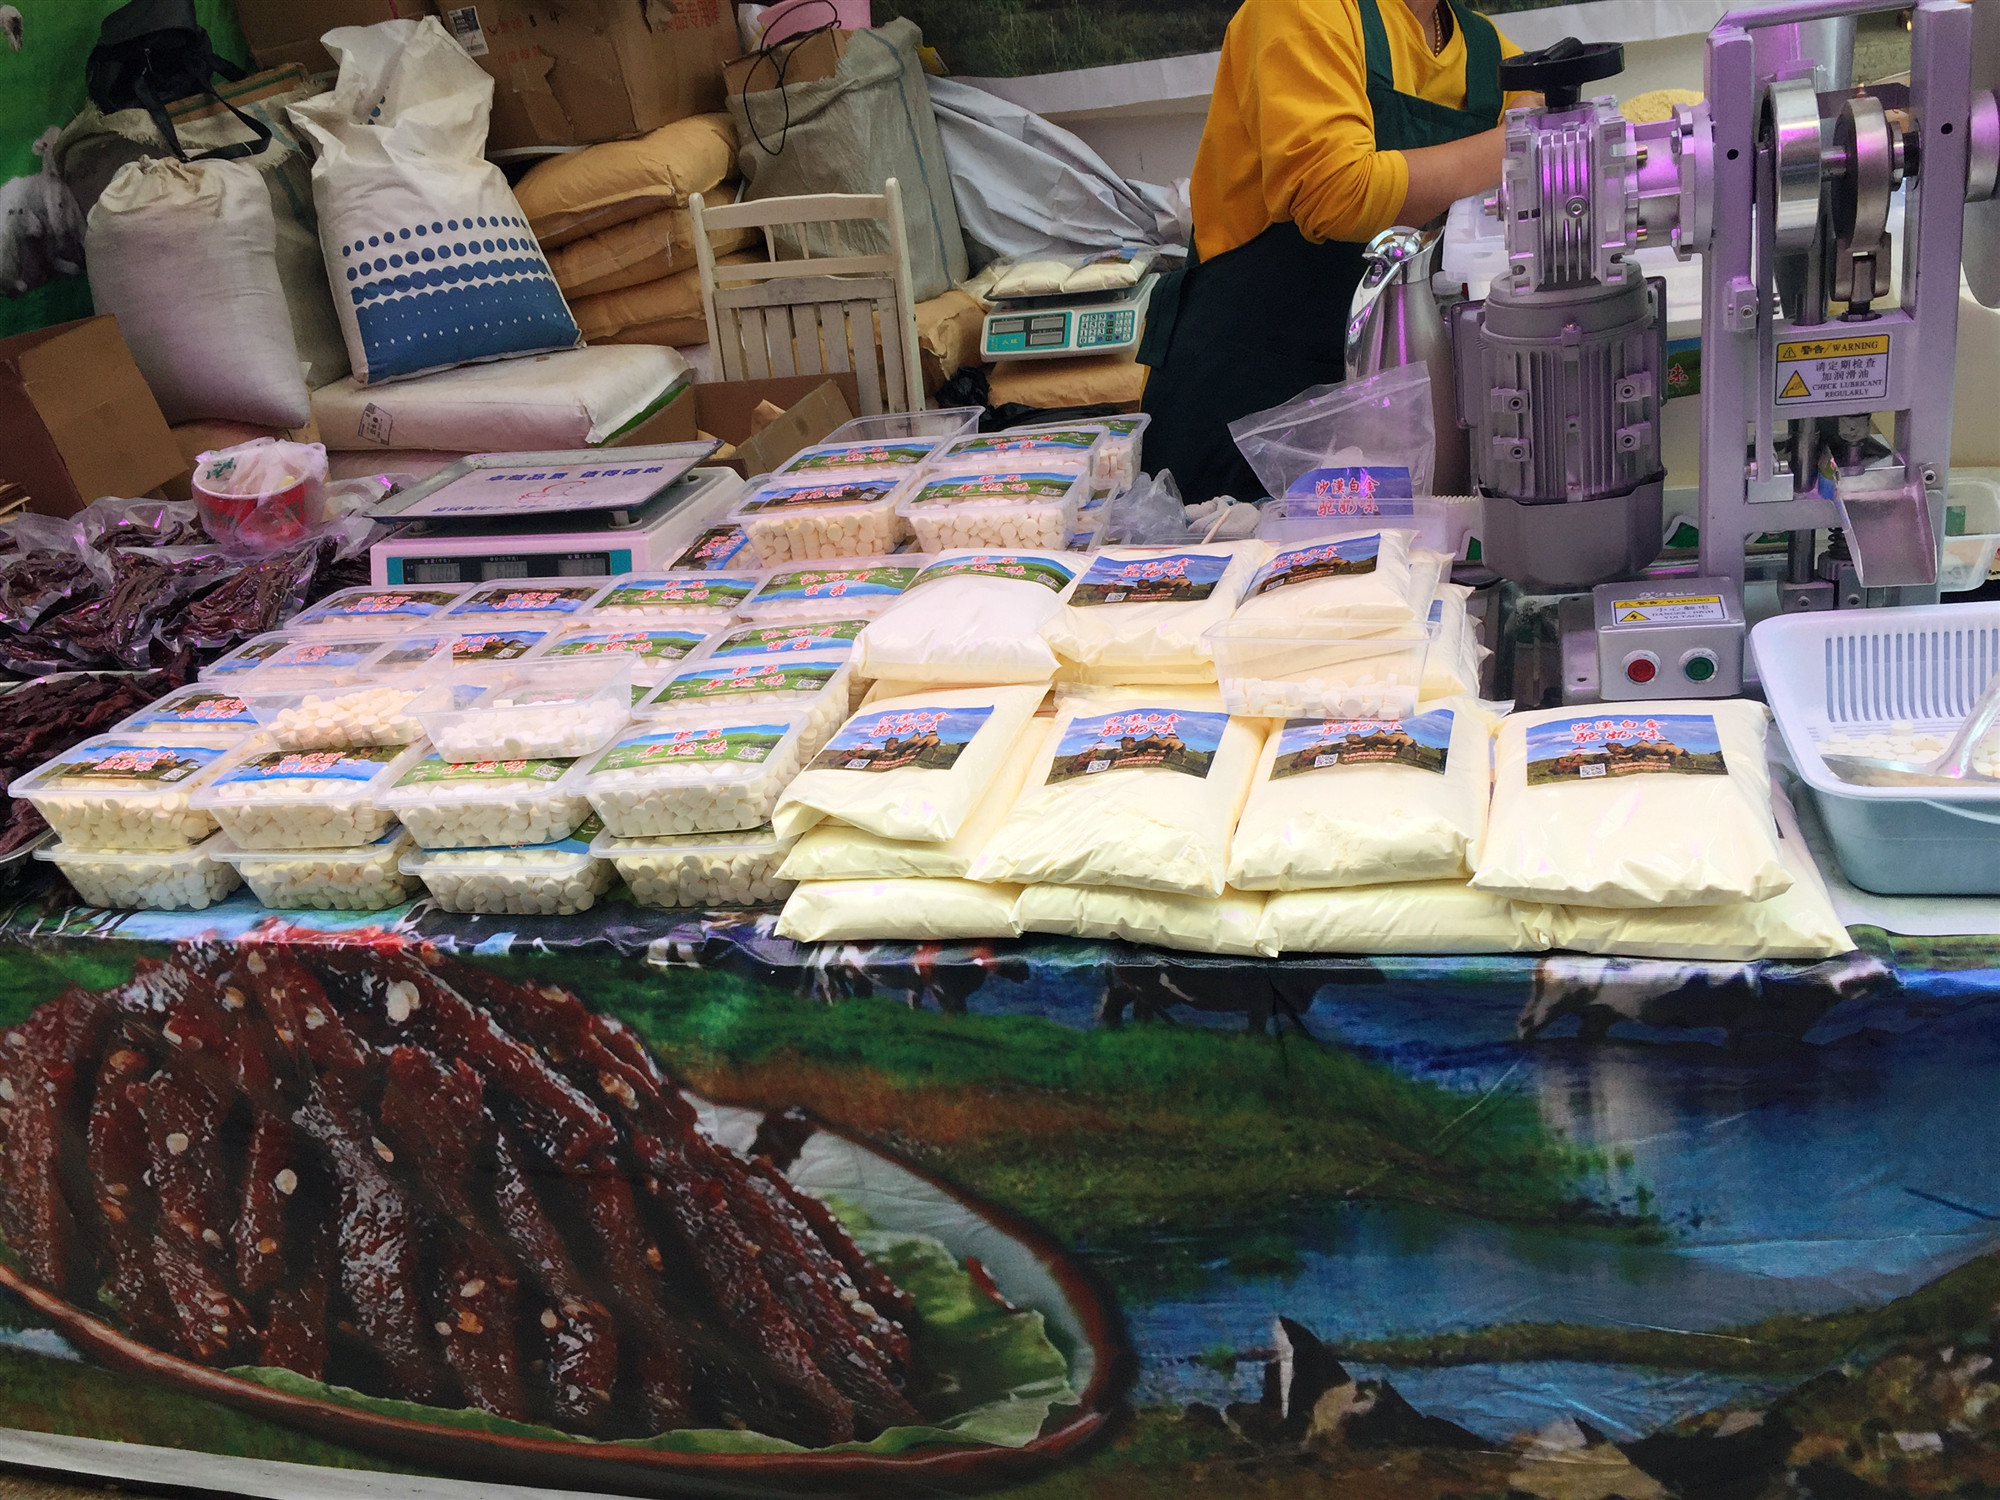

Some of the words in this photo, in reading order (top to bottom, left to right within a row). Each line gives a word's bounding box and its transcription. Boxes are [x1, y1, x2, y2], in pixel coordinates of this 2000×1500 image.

[1822, 369, 1869, 381] 加润滑油
[1812, 382, 1837, 391] CHECK
[1840, 379, 1882, 389] LUBRICANT
[1825, 388, 1869, 398] REGULARLY
[1316, 475, 1380, 496] 沙漠白金
[1317, 494, 1378, 516] 驼奶味
[878, 712, 952, 725] 沙漠白金
[1104, 713, 1186, 726] 沙漠白金
[1098, 722, 1176, 737] 驼奶味
[1571, 718, 1668, 733] 沙漠白金
[1572, 730, 1667, 744] 驼奶味
